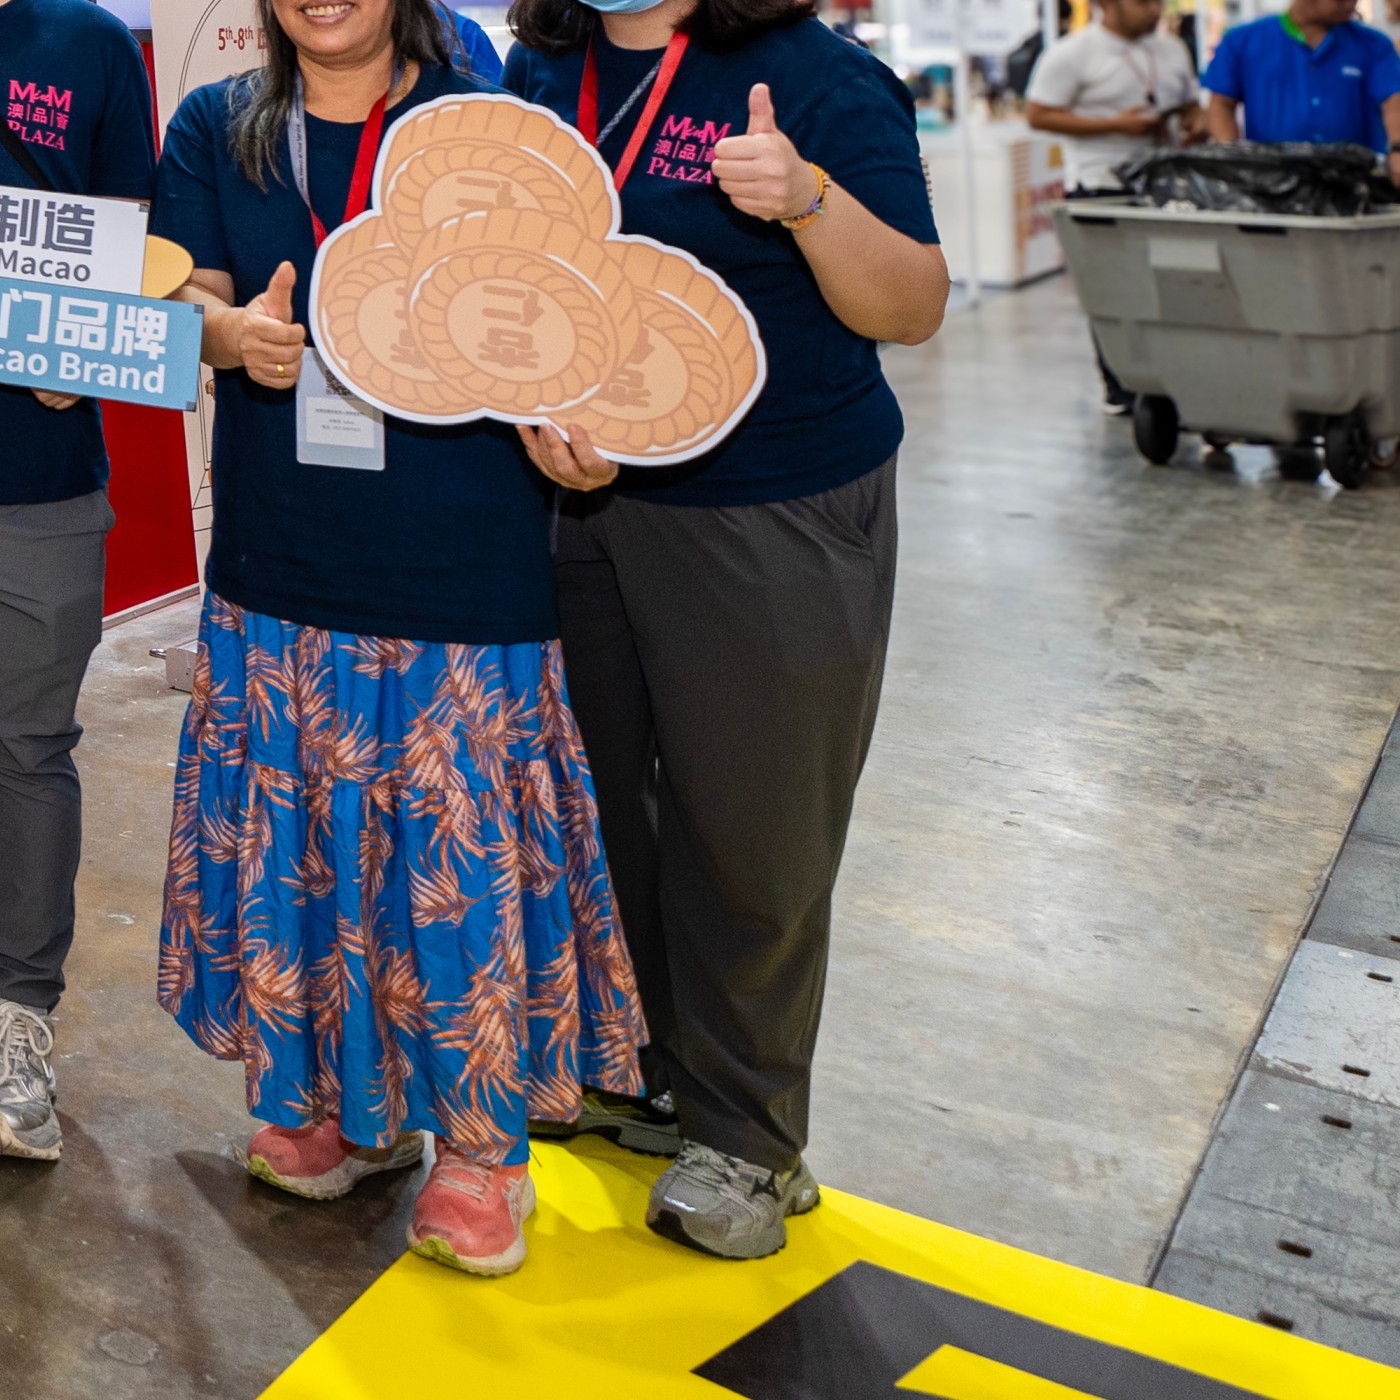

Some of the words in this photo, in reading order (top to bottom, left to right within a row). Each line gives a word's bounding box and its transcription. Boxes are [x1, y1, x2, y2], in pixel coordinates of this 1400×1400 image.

[218, 26, 254, 50] 5th-8th
[7, 119, 65, 151] PLAZA
[646, 156, 714, 186] PLAZA
[59, 351, 165, 394] Brand
